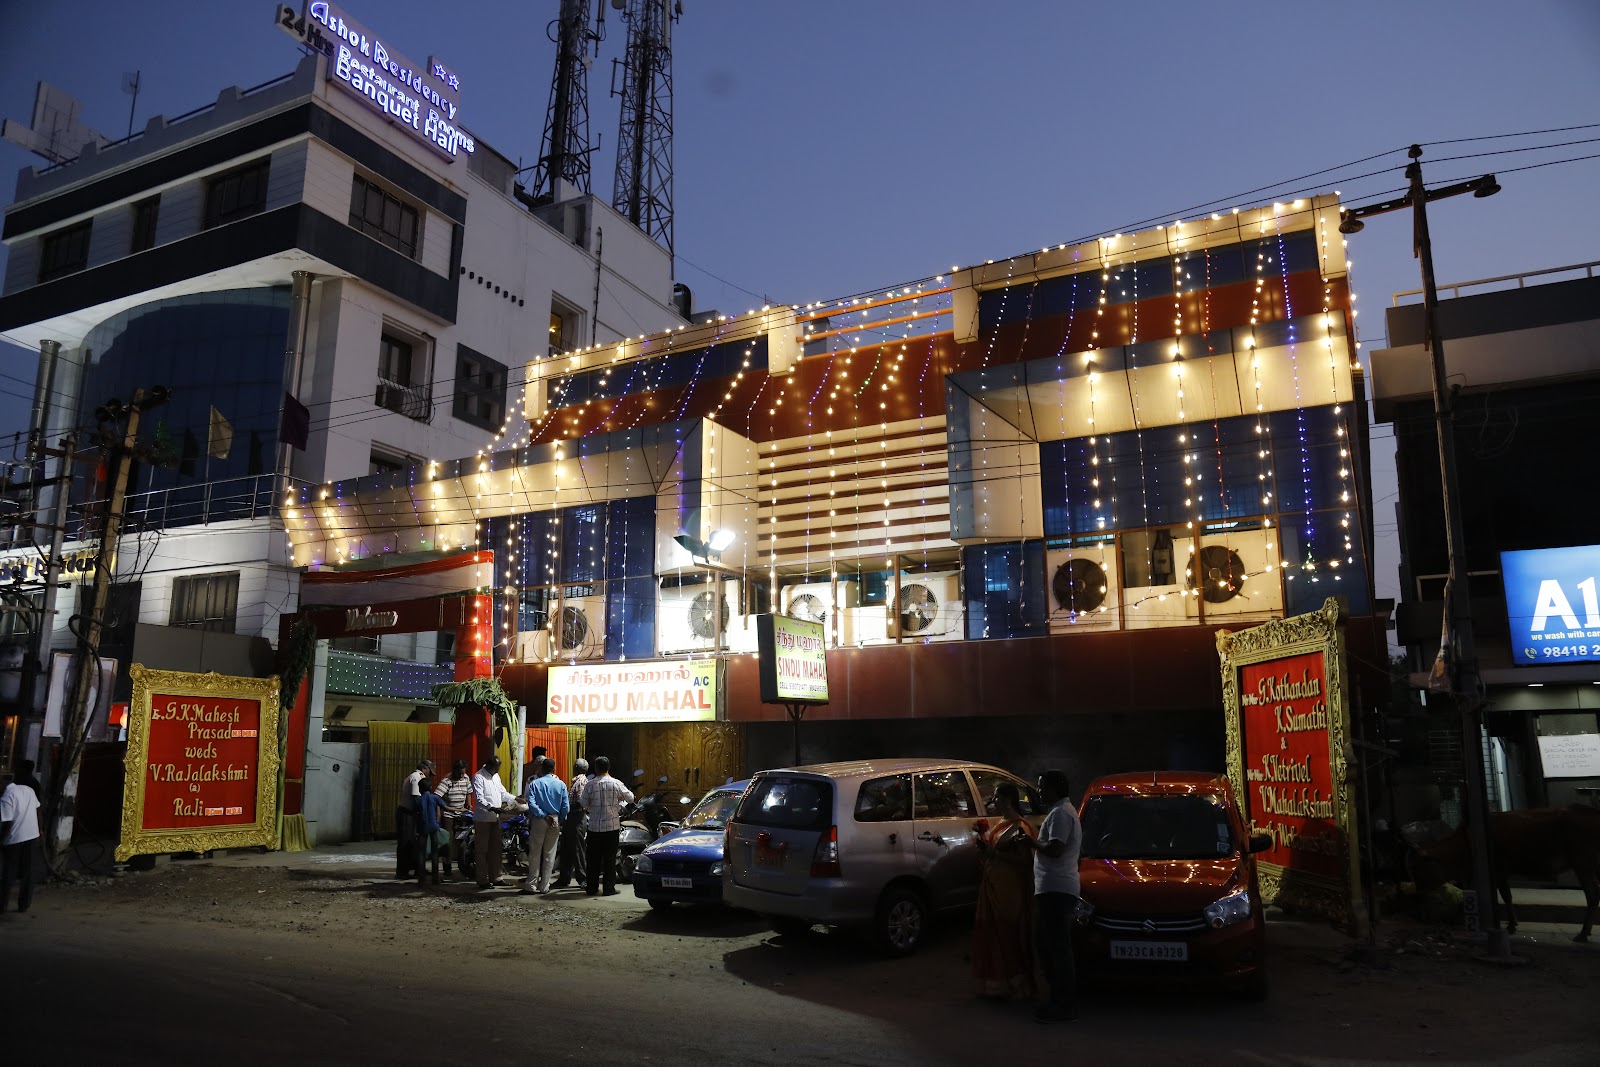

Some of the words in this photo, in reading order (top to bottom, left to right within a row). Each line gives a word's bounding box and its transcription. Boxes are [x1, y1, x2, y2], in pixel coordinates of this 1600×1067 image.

[281, 7, 306, 37] 24
[306, 24, 335, 57] Hrs
[310, 2, 370, 57] Ashok
[373, 41, 458, 120] Residency
[335, 57, 420, 130] Banquet
[423, 118, 459, 156] Hall
[428, 108, 475, 154] Rooms
[1530, 576, 1600, 632] A1
[345, 605, 399, 632] Welcome
[1531, 633, 1543, 641] we
[1544, 631, 1566, 640] wash
[1567, 630, 1585, 639] with
[1543, 645, 1588, 658] 98418
[693, 675, 710, 687] A/C
[777, 656, 801, 680] SINDU
[802, 660, 827, 682] MAHAL
[549, 691, 618, 715] SINDU
[626, 688, 712, 712] MAHAL
[1274, 699, 1328, 734] K.Sumathi
[187, 722, 233, 740] Prasad
[184, 742, 218, 759] weds
